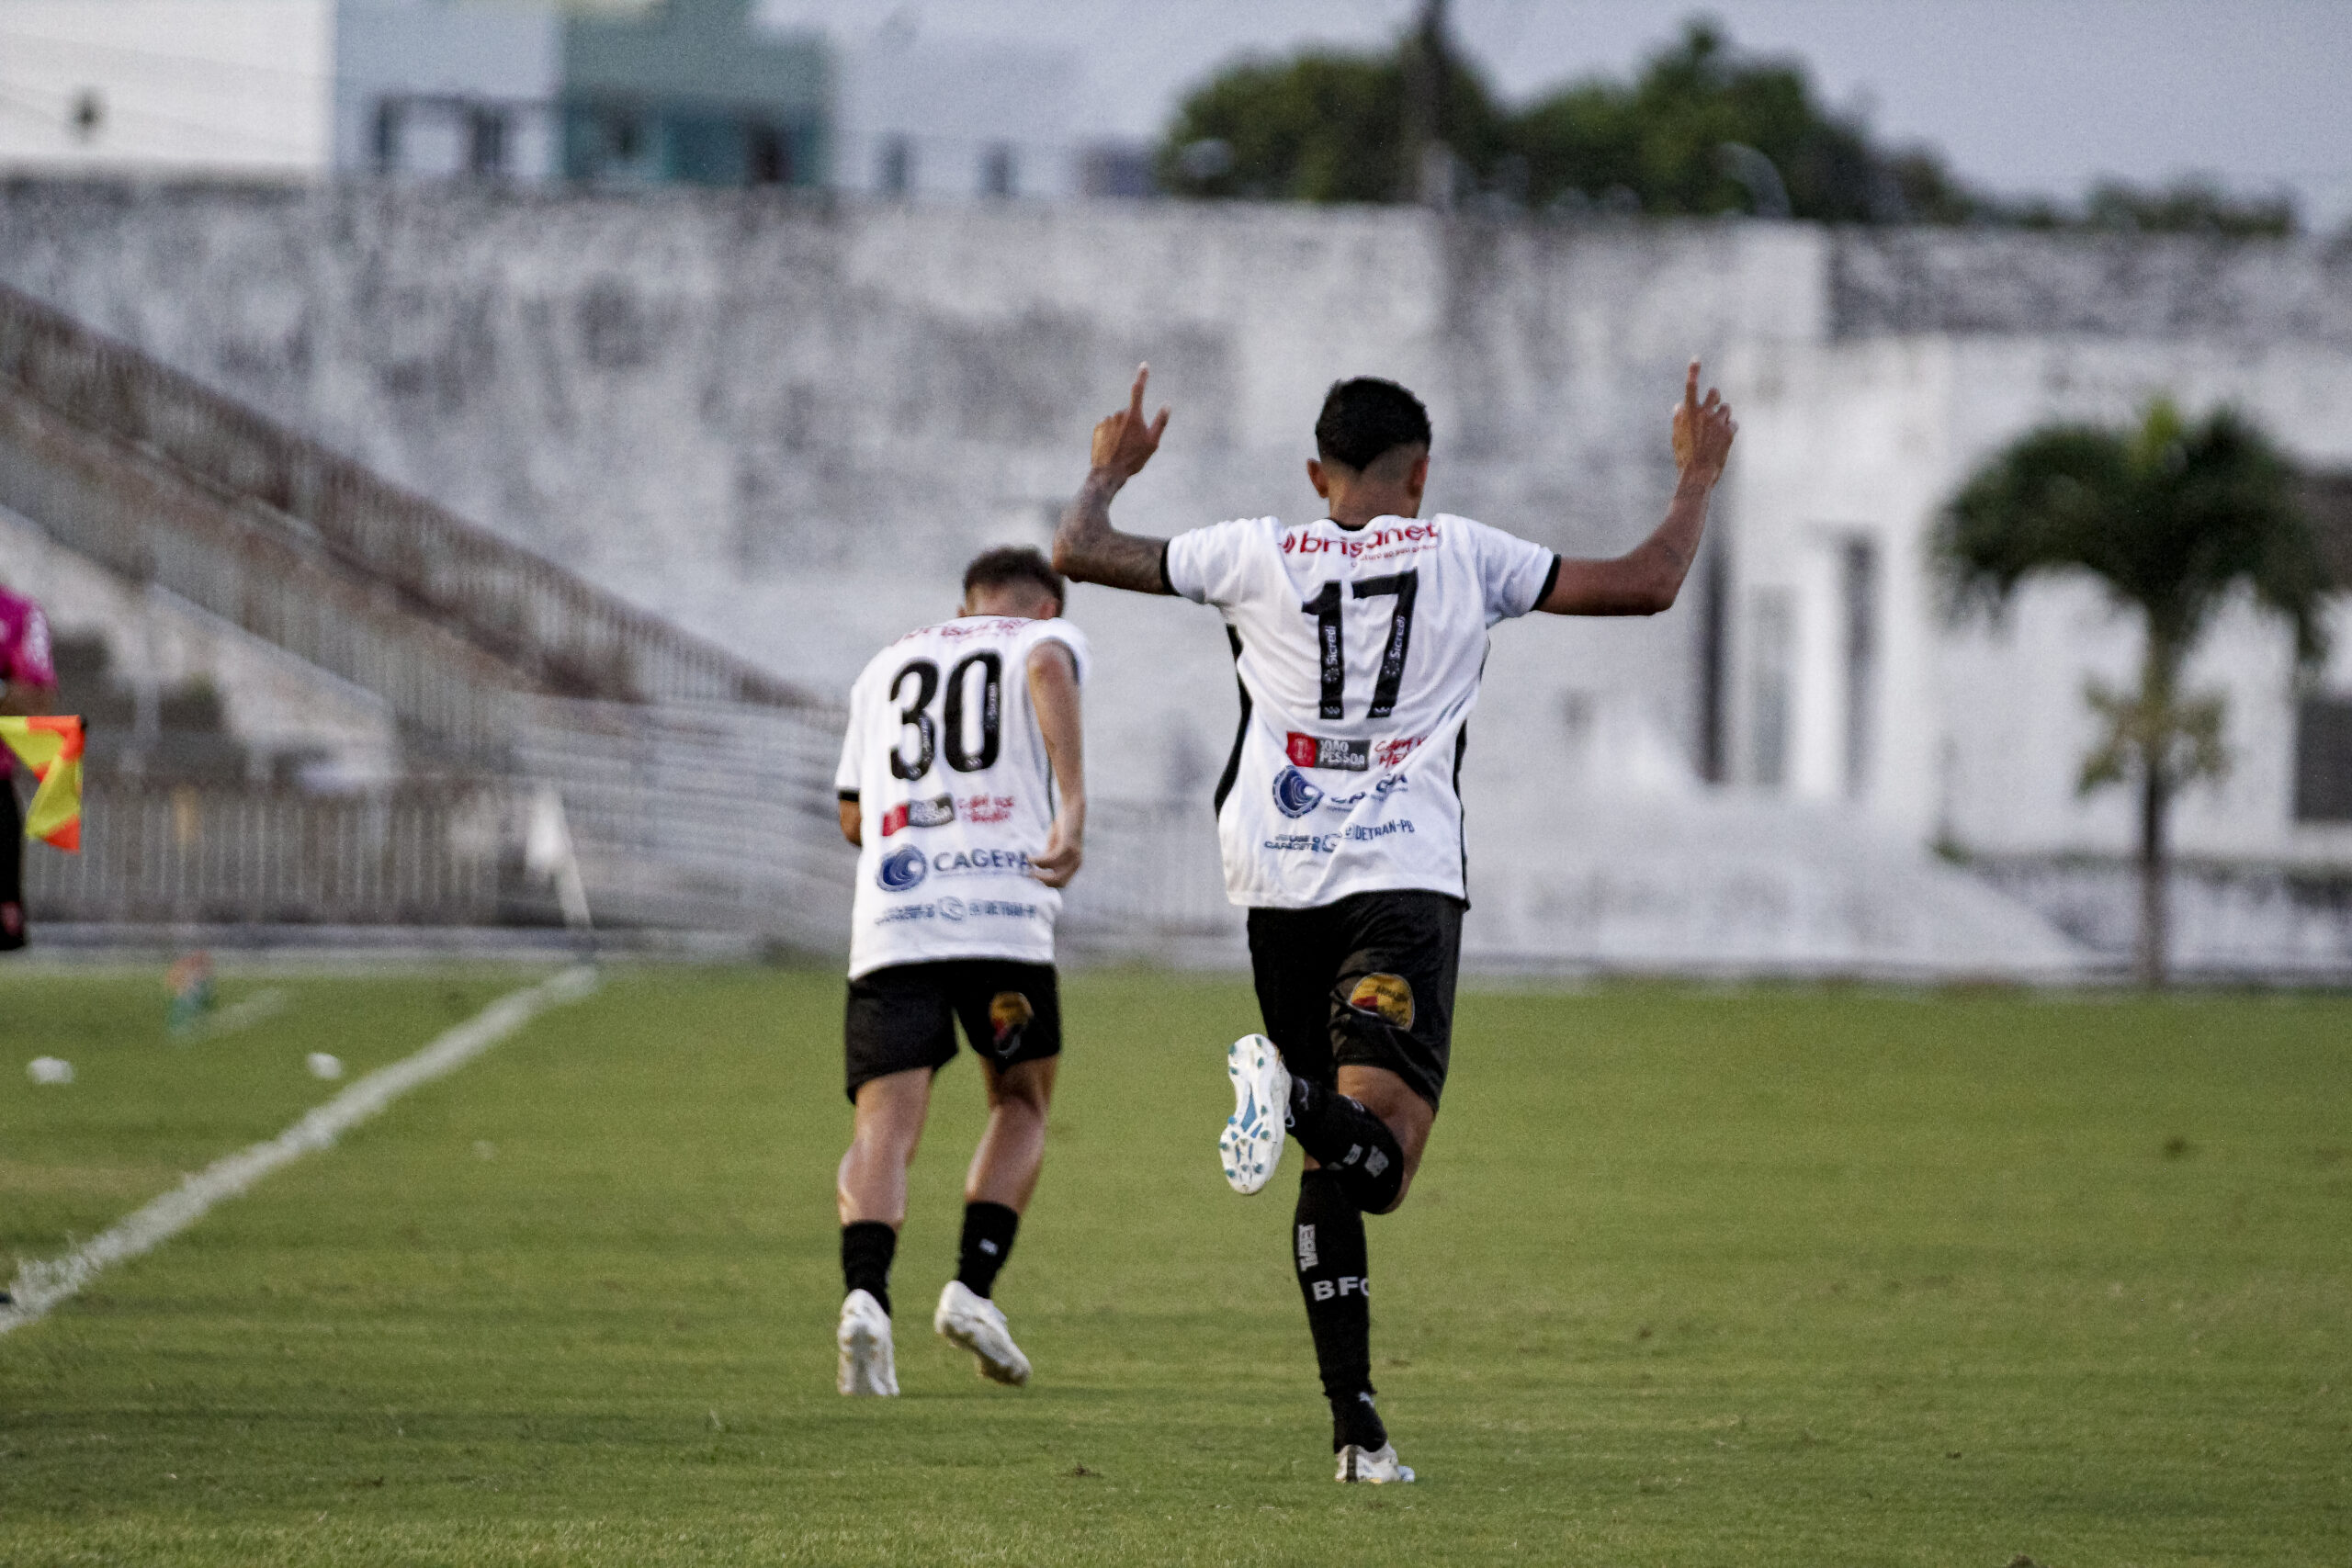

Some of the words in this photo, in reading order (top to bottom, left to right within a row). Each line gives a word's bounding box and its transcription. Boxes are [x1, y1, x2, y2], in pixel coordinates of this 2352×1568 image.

[1300, 522, 1439, 558] brisanet
[1301, 566, 1419, 719] 17
[1324, 625, 1339, 666] Sicredi
[1388, 615, 1406, 660] Sicredi
[890, 648, 1002, 781] 30
[1355, 819, 1415, 840] DETRAN-PB
